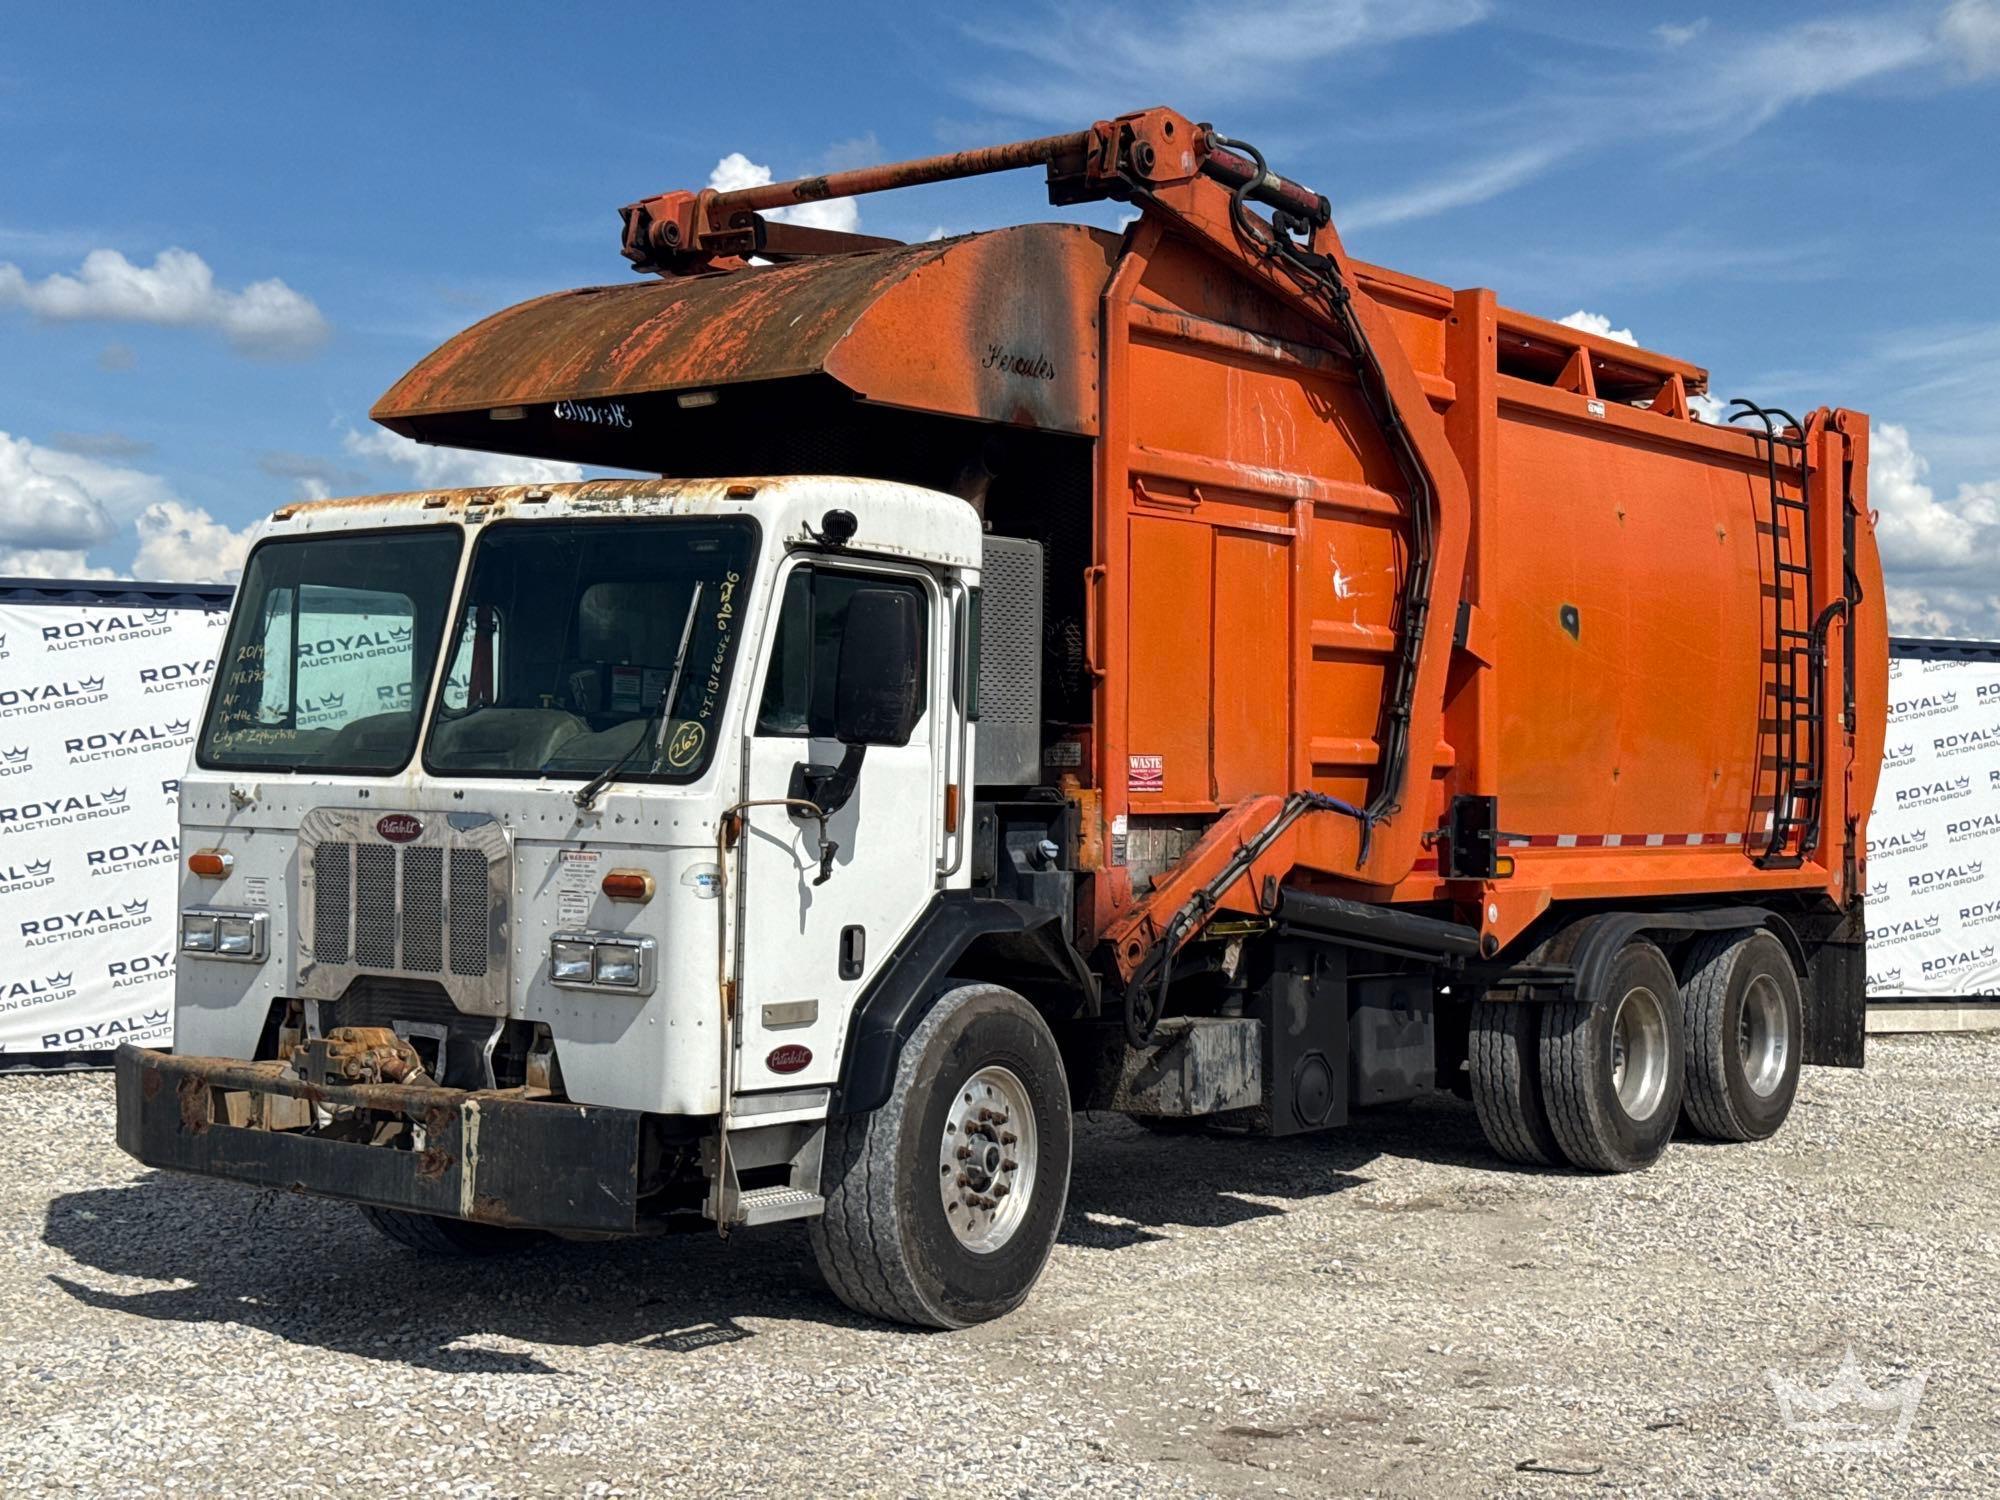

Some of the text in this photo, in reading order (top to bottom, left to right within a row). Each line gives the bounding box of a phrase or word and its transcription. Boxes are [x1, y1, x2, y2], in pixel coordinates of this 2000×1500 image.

[982, 344, 1054, 380] Hercules
[42, 614, 143, 641] ROYAL
[47, 626, 172, 652] AUCTION GROUP
[297, 632, 389, 657] ROYAL
[300, 652, 364, 669] AUCTION
[0, 682, 79, 706] OYAL
[0, 693, 109, 718] CTION GROUP
[1887, 696, 1942, 715] ROYAL
[1928, 704, 1959, 716] GROUP
[297, 710, 348, 725] GROUP
[65, 726, 166, 753] ROYAL
[1934, 729, 1992, 750] ROYAL
[1936, 739, 2000, 758] AUCTION GROU
[69, 736, 195, 765] AUCTION GROUP
[0, 764, 33, 777] OUP
[1130, 757, 1162, 769] WASTE
[1883, 756, 1916, 769] GROUP
[1896, 780, 1955, 802] ROYAL
[1898, 789, 1972, 811] AUCTION GROUP
[0, 794, 102, 823] ROYAL
[2, 804, 131, 835] AUCTION GROUP
[1866, 834, 1911, 853] OYAL
[1949, 830, 1988, 843] AUCTION
[1896, 843, 1929, 856] GROUP
[91, 857, 160, 877] AUCTION
[1908, 866, 1968, 887] ROYAL
[1, 876, 55, 894] GROUP
[1911, 874, 1984, 896] AUCTION GROUP
[1864, 895, 1890, 906] ROUP
[1960, 900, 2000, 919] ROYA
[21, 906, 123, 937] ROYAL
[24, 916, 152, 948] AUCTION GROUP
[1865, 919, 1924, 941] ROYAL
[1867, 928, 1941, 950] AUCTION GROUP
[108, 952, 176, 978] ROY
[1922, 950, 1980, 973] ROYAL
[112, 969, 176, 989] AUCTION
[21, 989, 76, 1007] GROUP
[42, 1017, 144, 1049] ROYAL
[119, 1026, 173, 1045] GROUP
